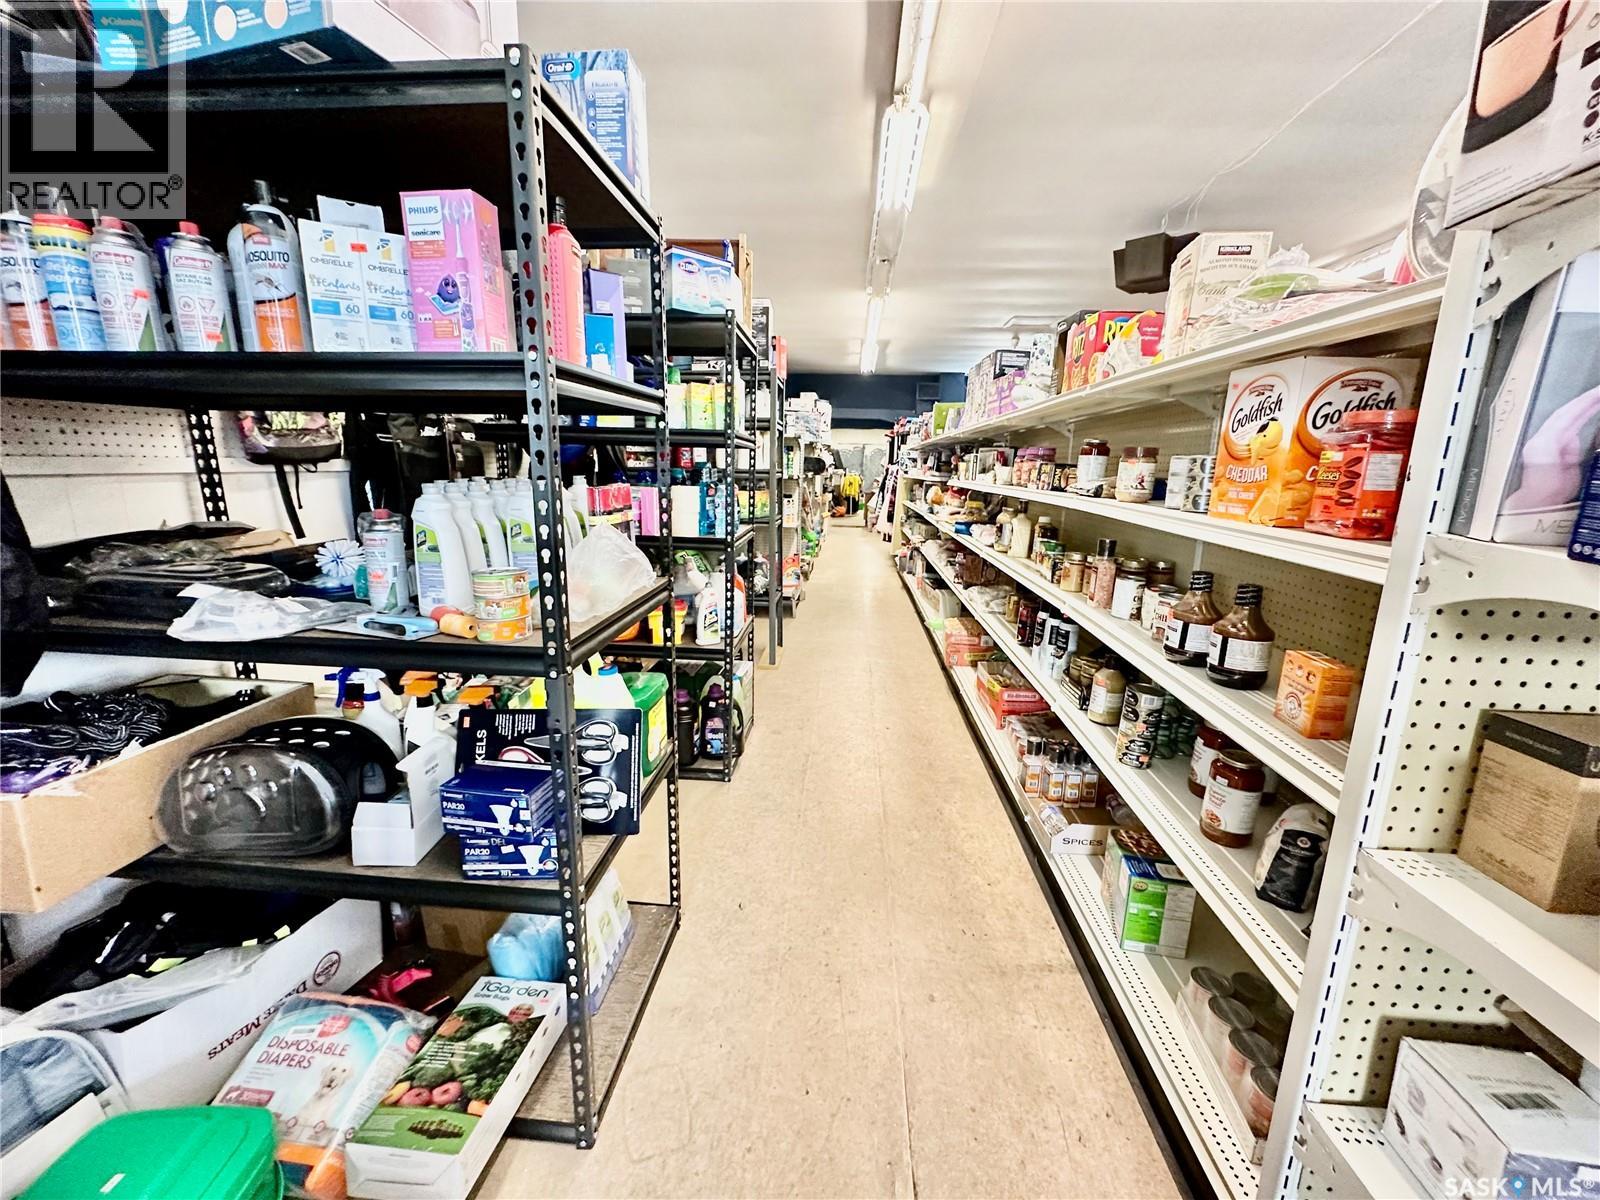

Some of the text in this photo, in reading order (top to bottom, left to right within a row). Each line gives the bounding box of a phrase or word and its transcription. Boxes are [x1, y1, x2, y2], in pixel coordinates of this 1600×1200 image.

[408, 206, 439, 215] PHILIPS
[310, 256, 354, 268] OMBRELLE
[368, 264, 409, 276] OMBRELLE
[322, 278, 361, 292] Enfants
[345, 304, 361, 314] 60
[400, 310, 414, 320] 60
[1231, 392, 1283, 434] Goldfish
[1225, 464, 1268, 484] CHEDDAR
[442, 801, 465, 811] PAR20
[1062, 837, 1104, 847] SPICES
[464, 848, 491, 856] PAR20
[207, 1016, 262, 1060] MEATS
[267, 1035, 350, 1057] DISPOSABLE
[256, 1050, 316, 1070] DIAPERS
